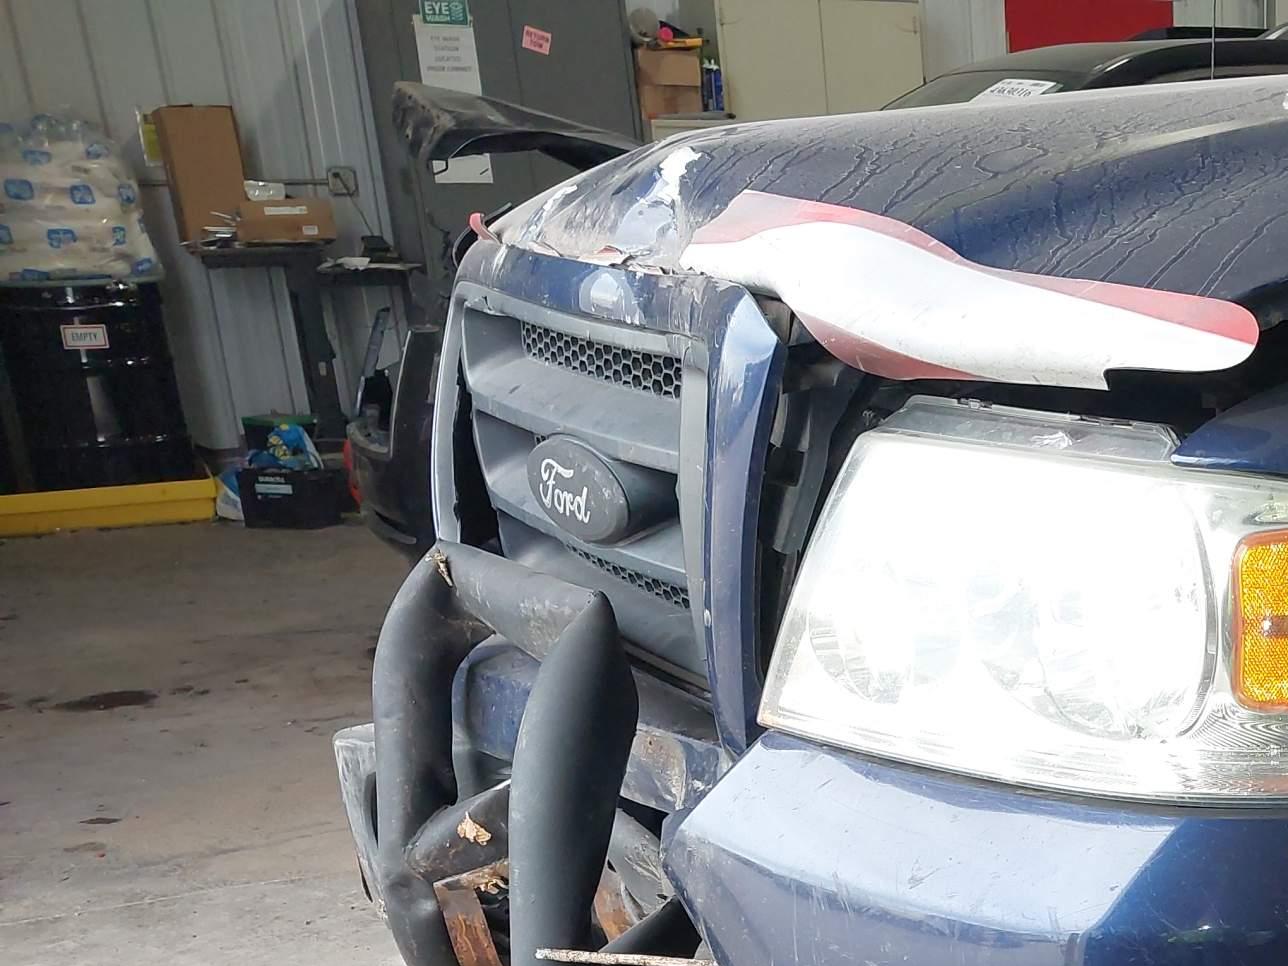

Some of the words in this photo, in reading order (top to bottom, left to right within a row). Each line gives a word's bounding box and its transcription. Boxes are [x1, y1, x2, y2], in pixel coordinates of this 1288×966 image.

[424, 1, 450, 15] EYE
[72, 332, 98, 342] EMPTY
[539, 458, 591, 525] Ford
